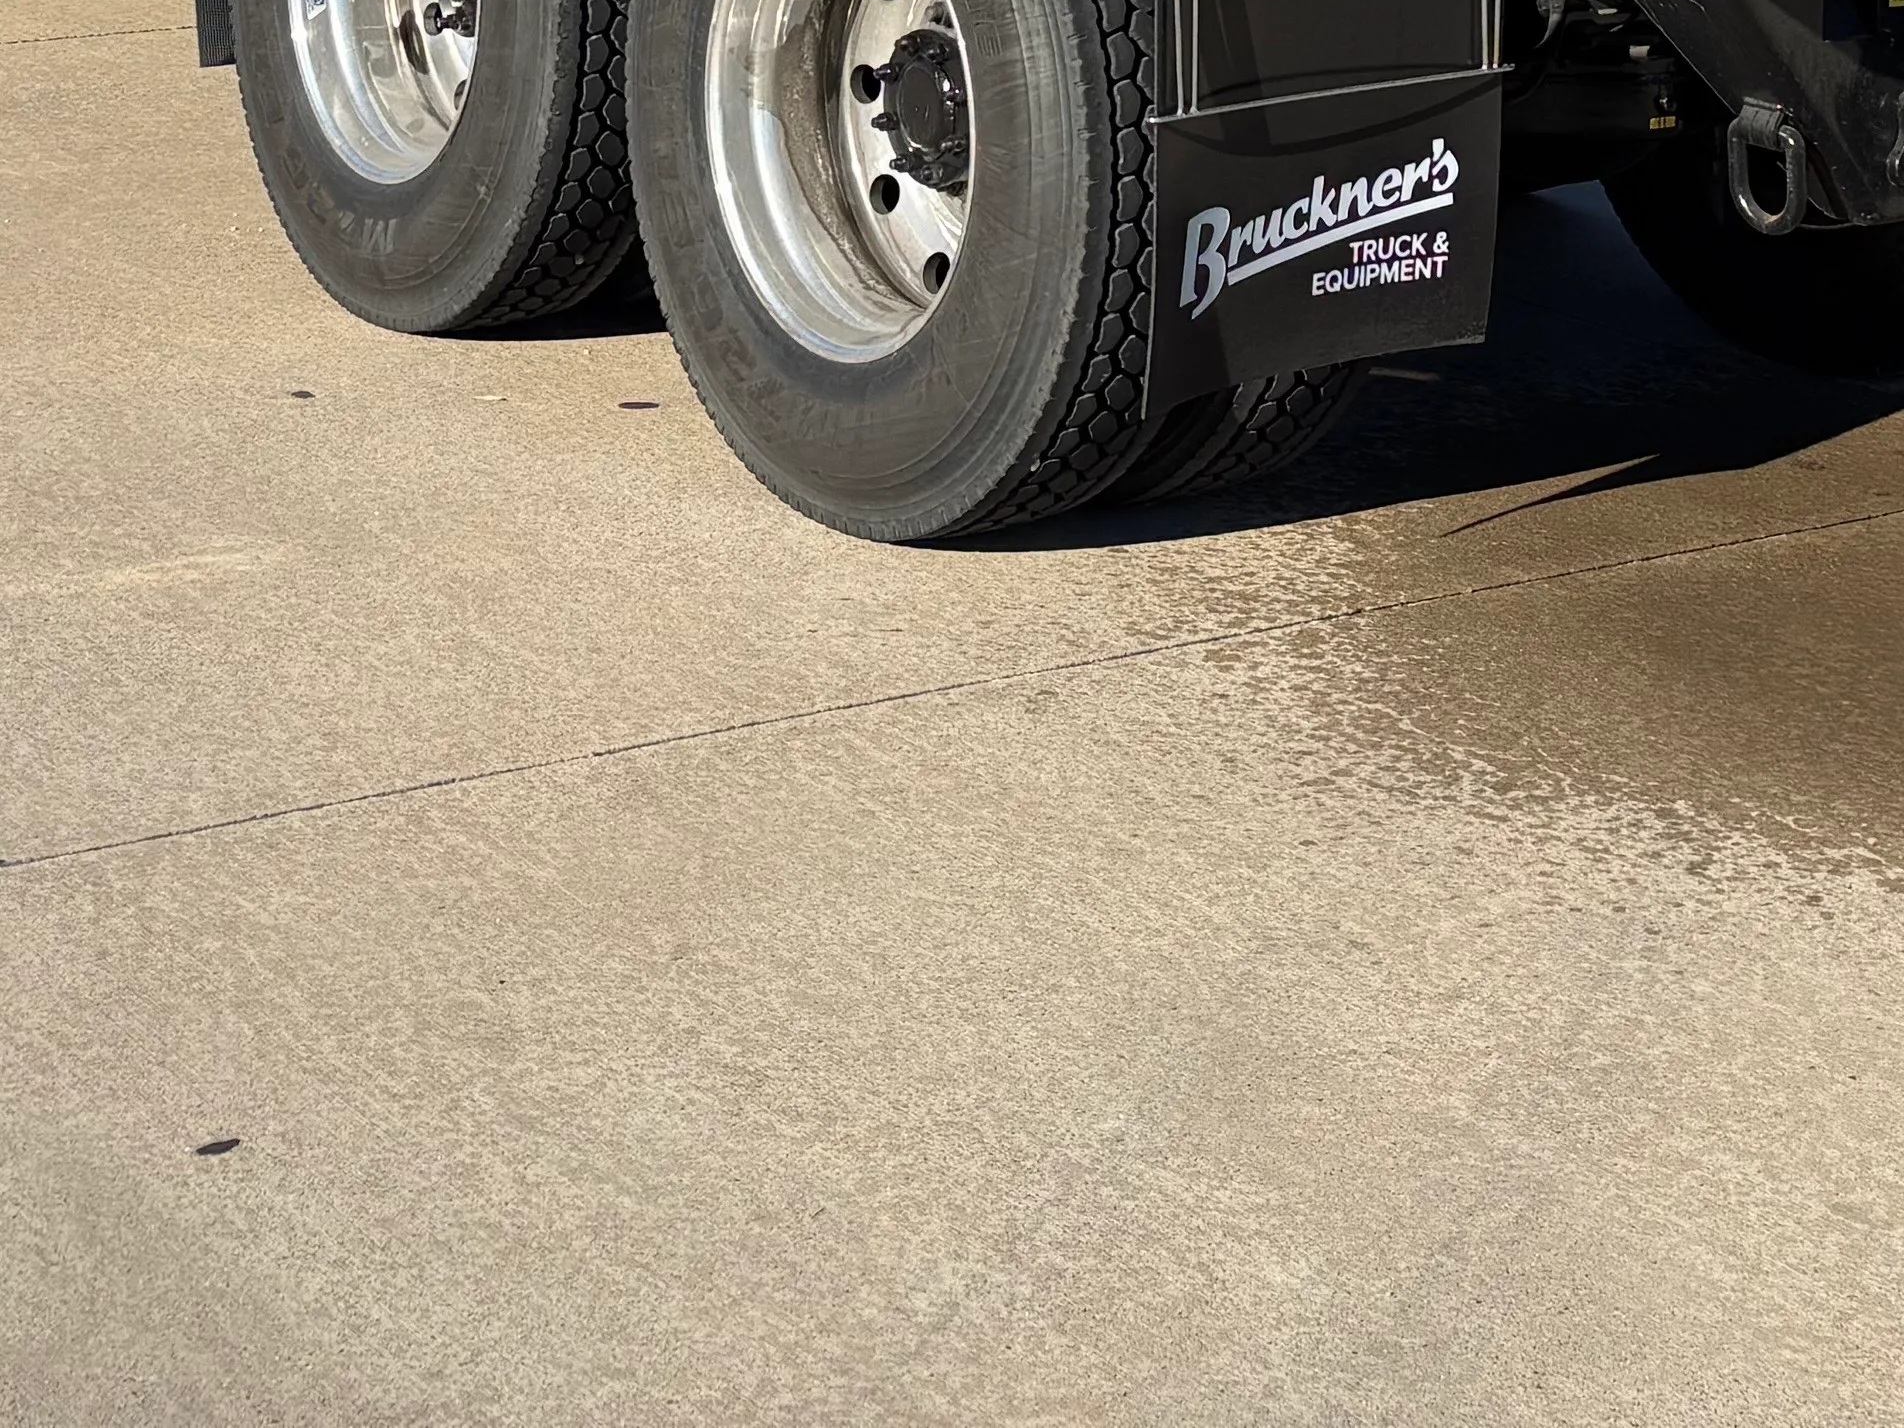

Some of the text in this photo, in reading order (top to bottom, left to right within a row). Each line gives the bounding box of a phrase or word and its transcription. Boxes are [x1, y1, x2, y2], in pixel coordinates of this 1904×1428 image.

[1179, 138, 1459, 320] Bruckner's
[1349, 231, 1450, 264] TRUCK &
[1311, 256, 1449, 296] EQUIPMENT
